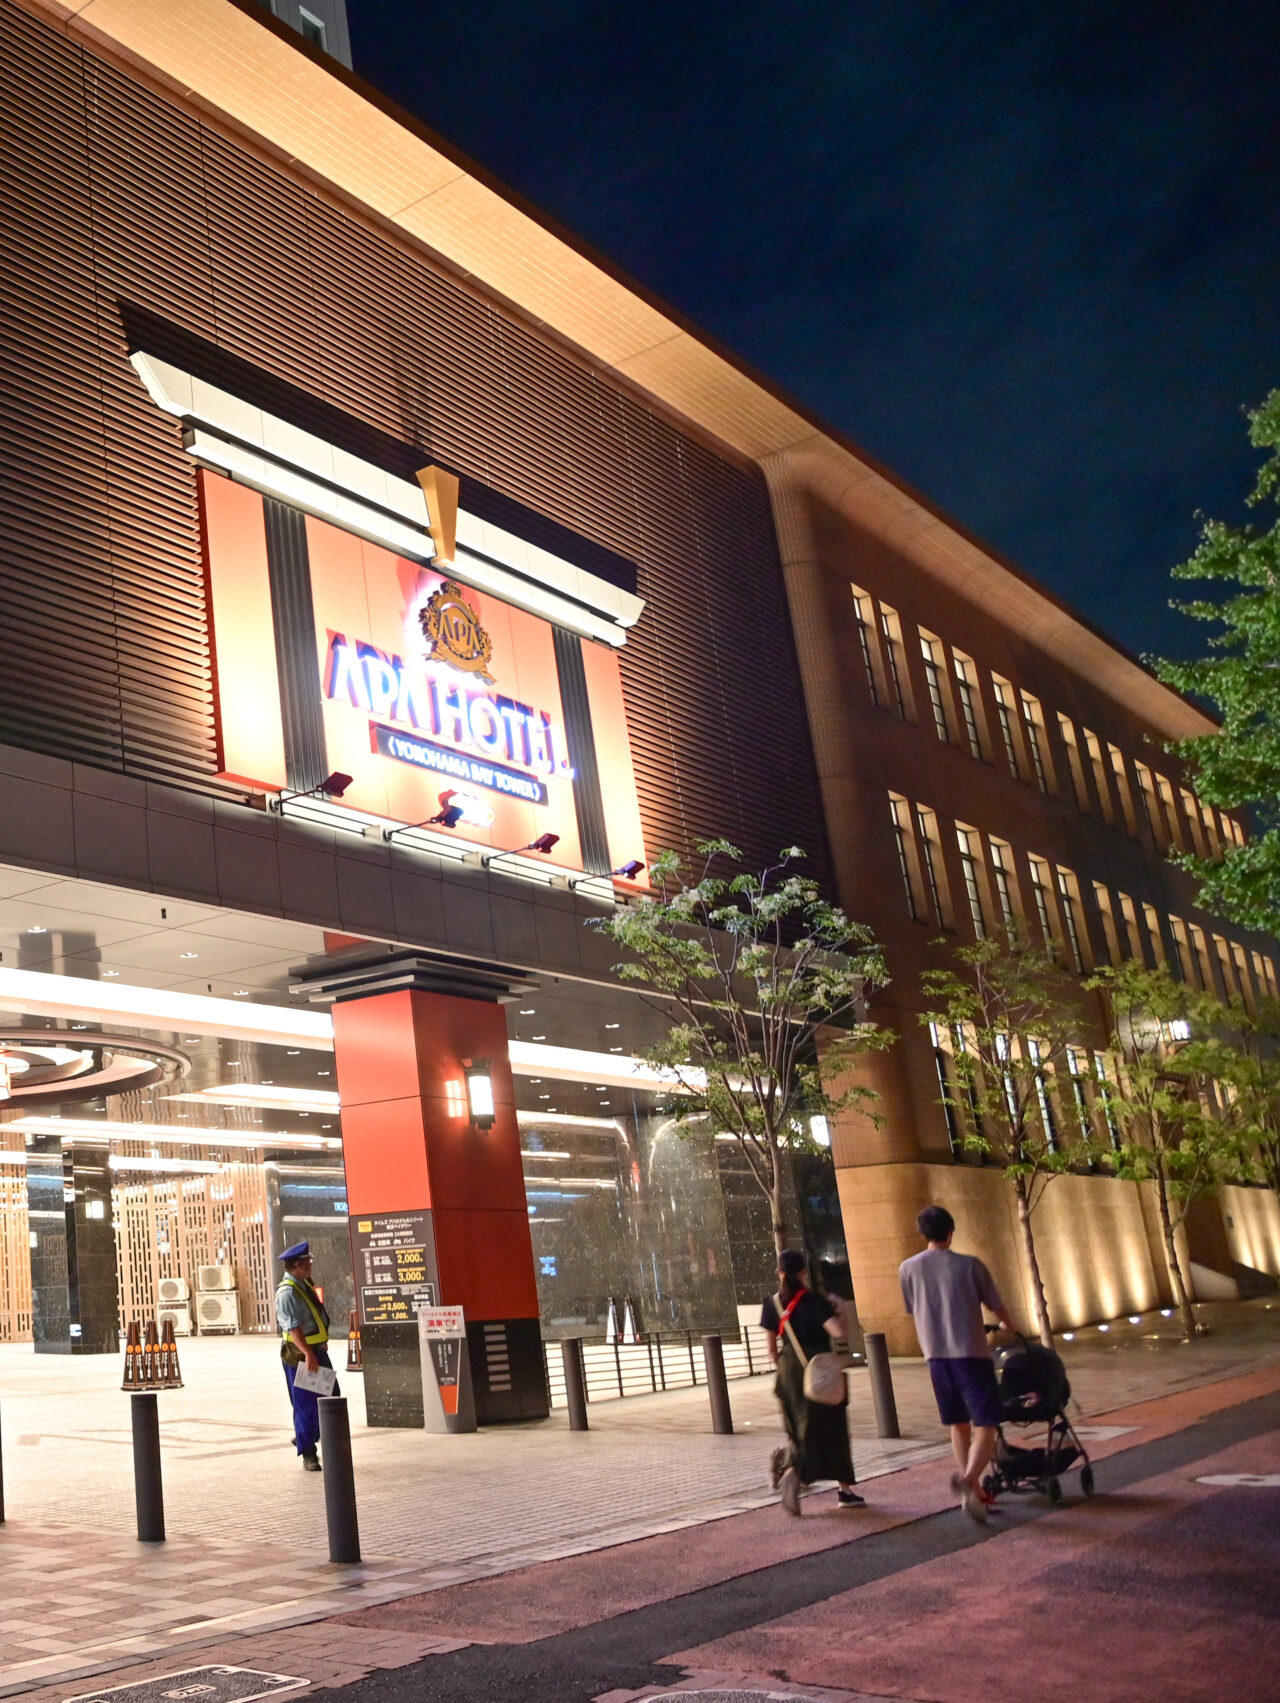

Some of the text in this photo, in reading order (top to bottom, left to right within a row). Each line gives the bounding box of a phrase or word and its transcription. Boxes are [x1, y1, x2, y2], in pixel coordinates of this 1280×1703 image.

[326, 641, 579, 781] APA HOTEL
[470, 759, 497, 786] BAY
